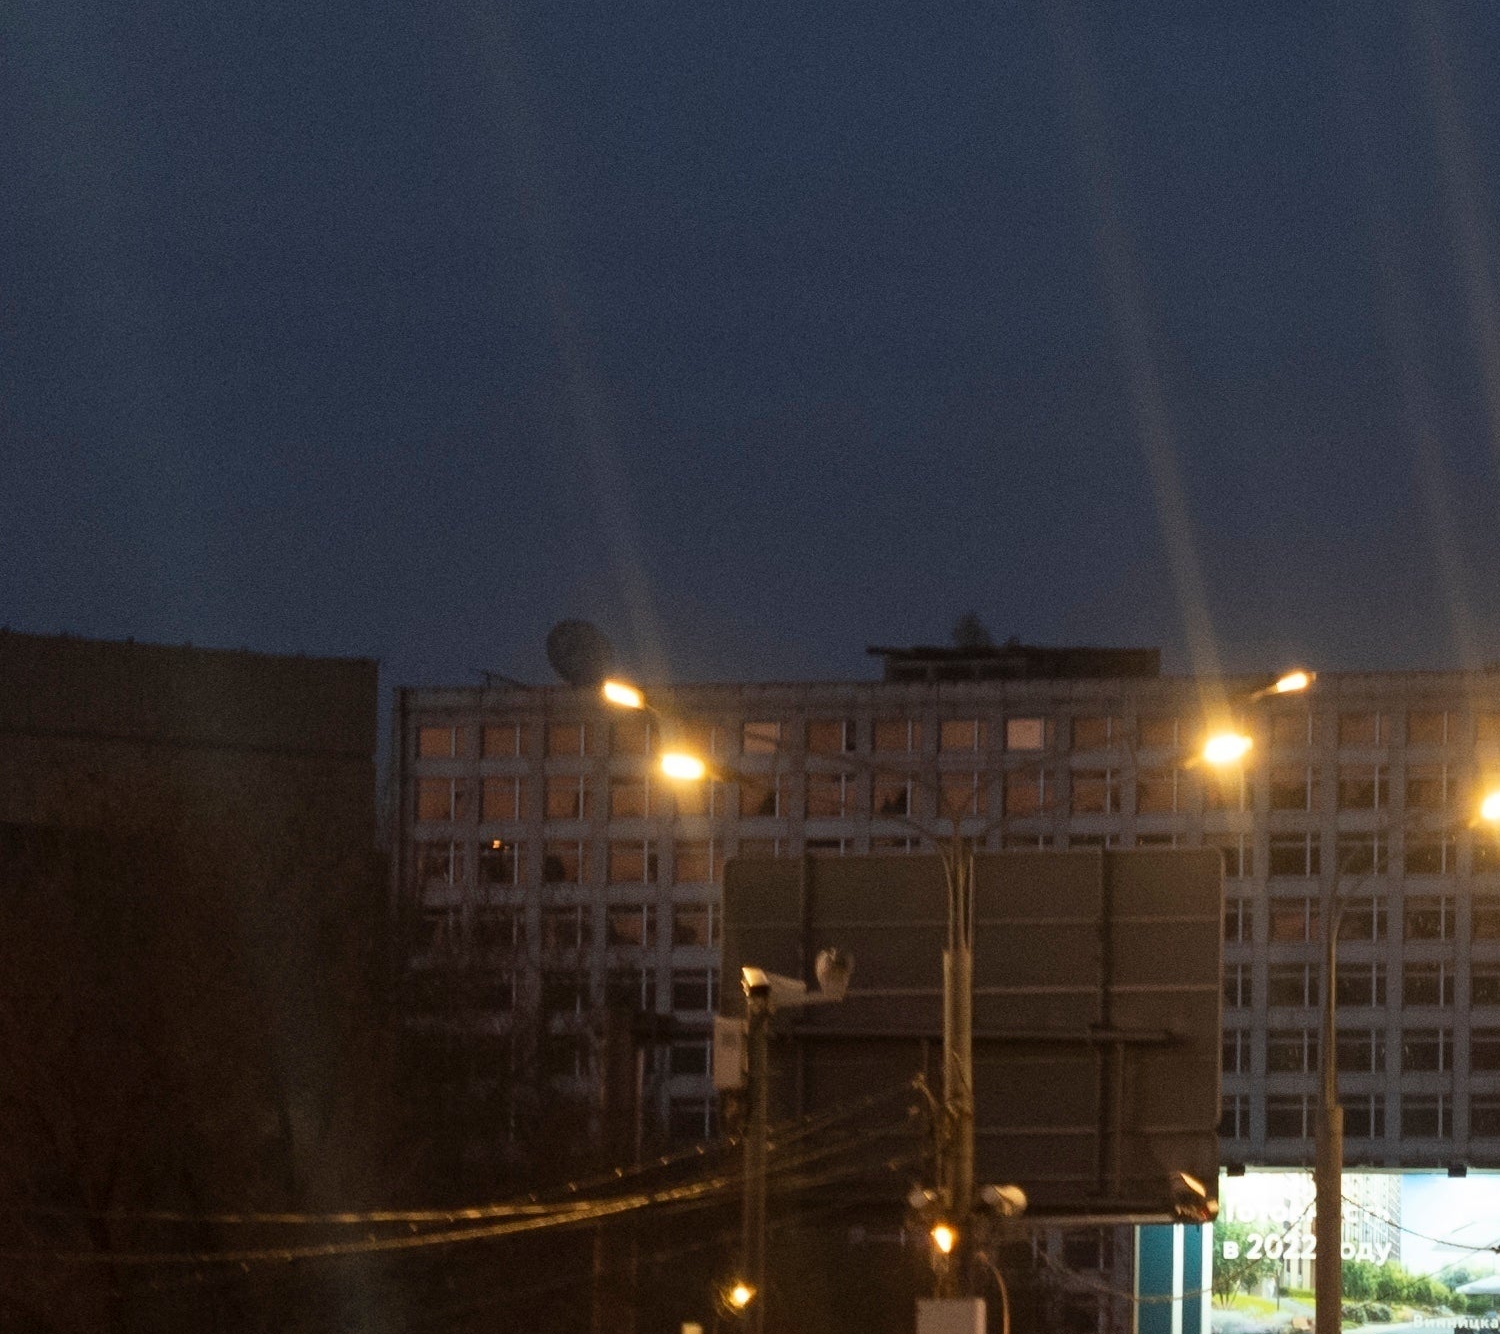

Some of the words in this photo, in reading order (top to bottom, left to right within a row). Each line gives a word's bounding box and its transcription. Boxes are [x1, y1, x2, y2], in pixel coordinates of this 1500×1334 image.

[1223, 1240, 1239, 1260] в
[1246, 1233, 1317, 1260] 2022
[1341, 1241, 1392, 1267] оду
